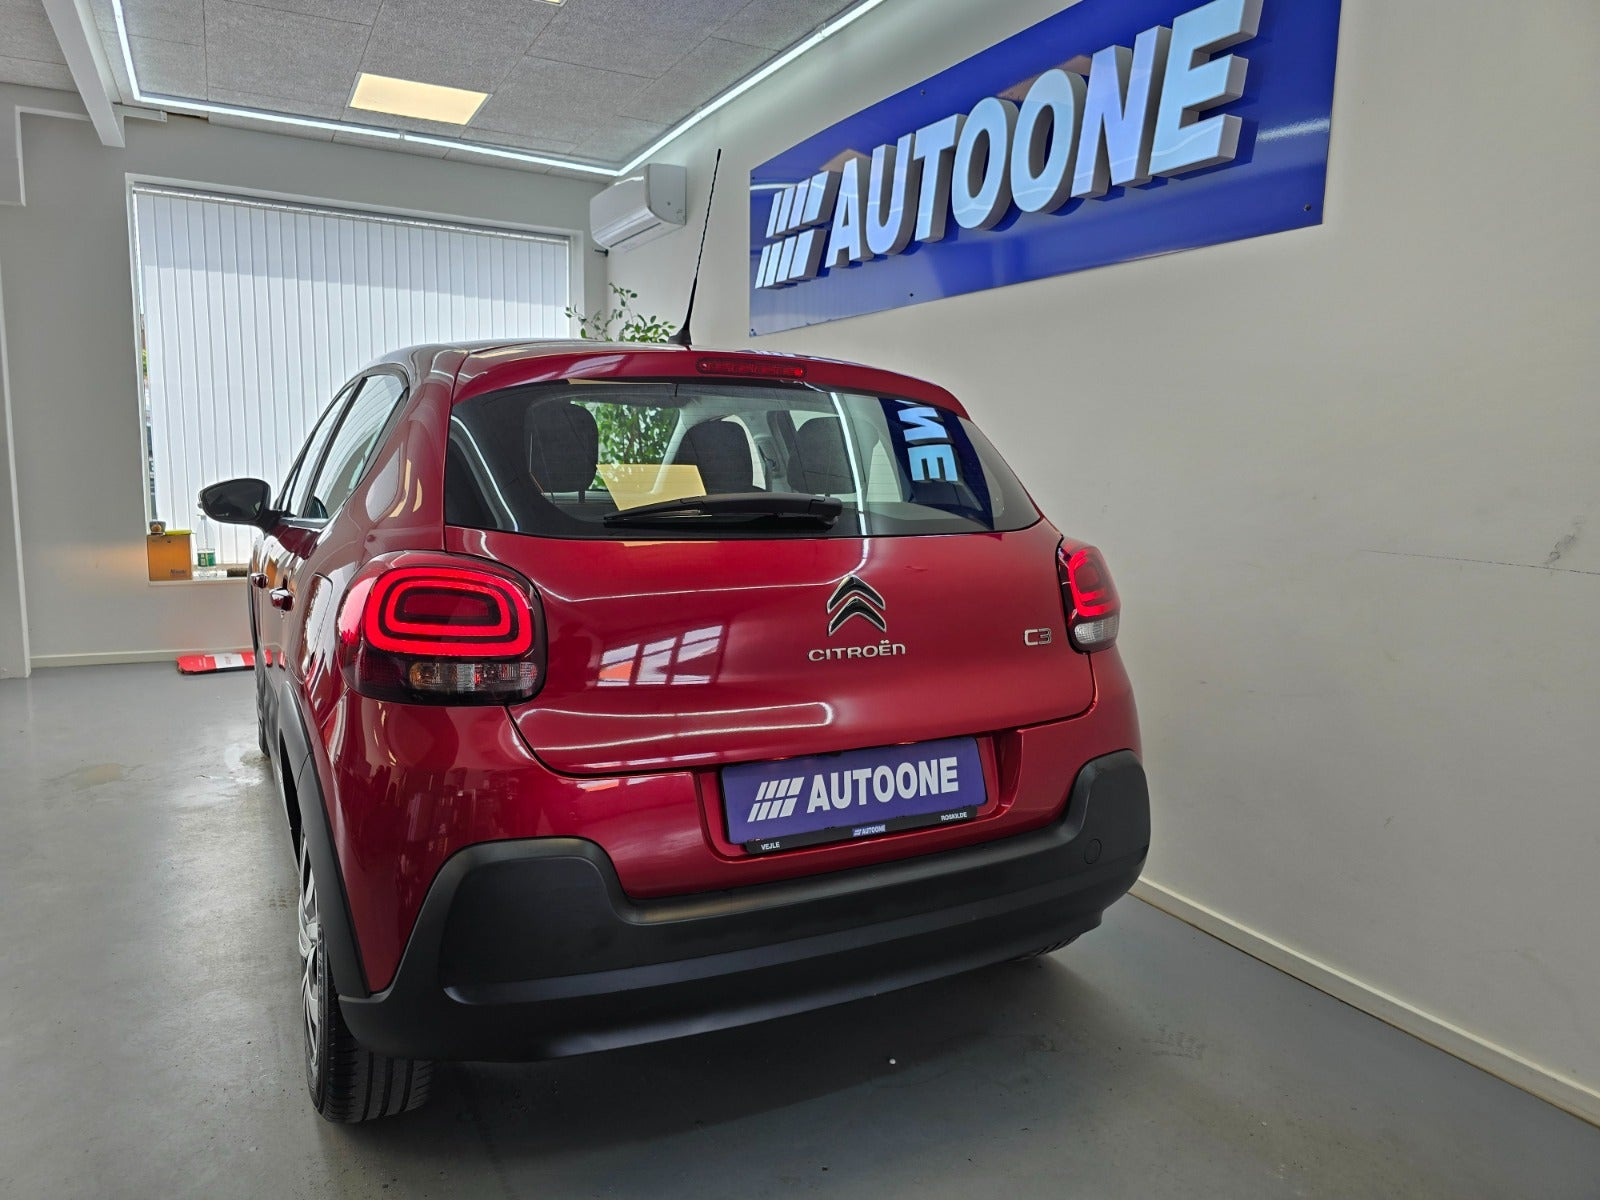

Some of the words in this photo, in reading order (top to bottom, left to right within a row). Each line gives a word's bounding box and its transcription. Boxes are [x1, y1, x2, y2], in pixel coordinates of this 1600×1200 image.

[825, 0, 1264, 269] AUTOONE
[1024, 627, 1051, 646] C3
[808, 639, 906, 662] CITROËN
[806, 756, 959, 814] AUTOONE
[760, 841, 780, 851] VEJLE
